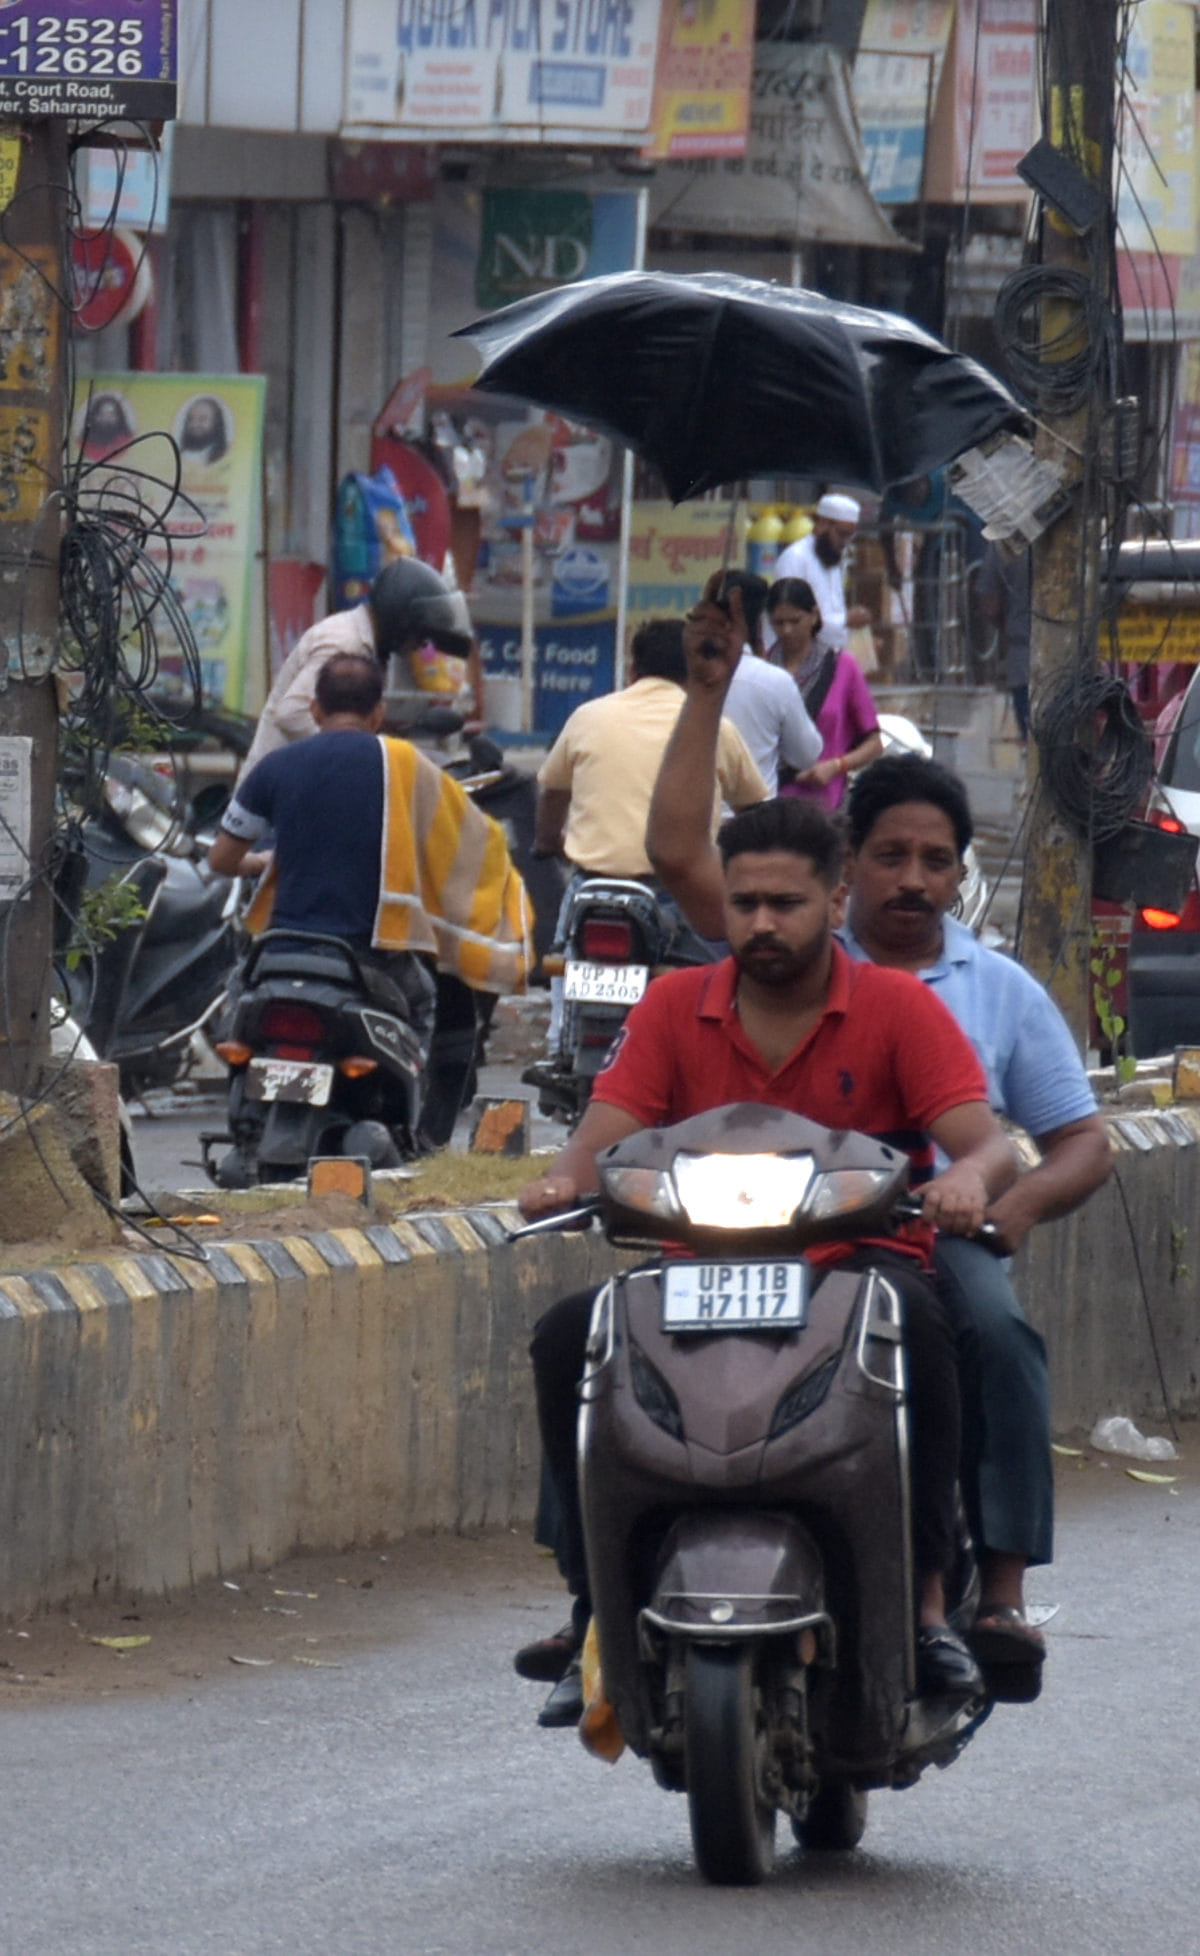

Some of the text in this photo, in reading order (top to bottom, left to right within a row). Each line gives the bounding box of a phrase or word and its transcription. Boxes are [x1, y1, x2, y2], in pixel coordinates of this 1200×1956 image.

[15, 82, 61, 97] Court
[66, 83, 115, 99] Road,
[29, 98, 127, 117] Saharanpur
[479, 640, 495, 660] &
[545, 642, 598, 665] Food
[541, 671, 592, 691] Here
[700, 1265, 788, 1292] UP11B
[698, 1294, 788, 1317] H7117
